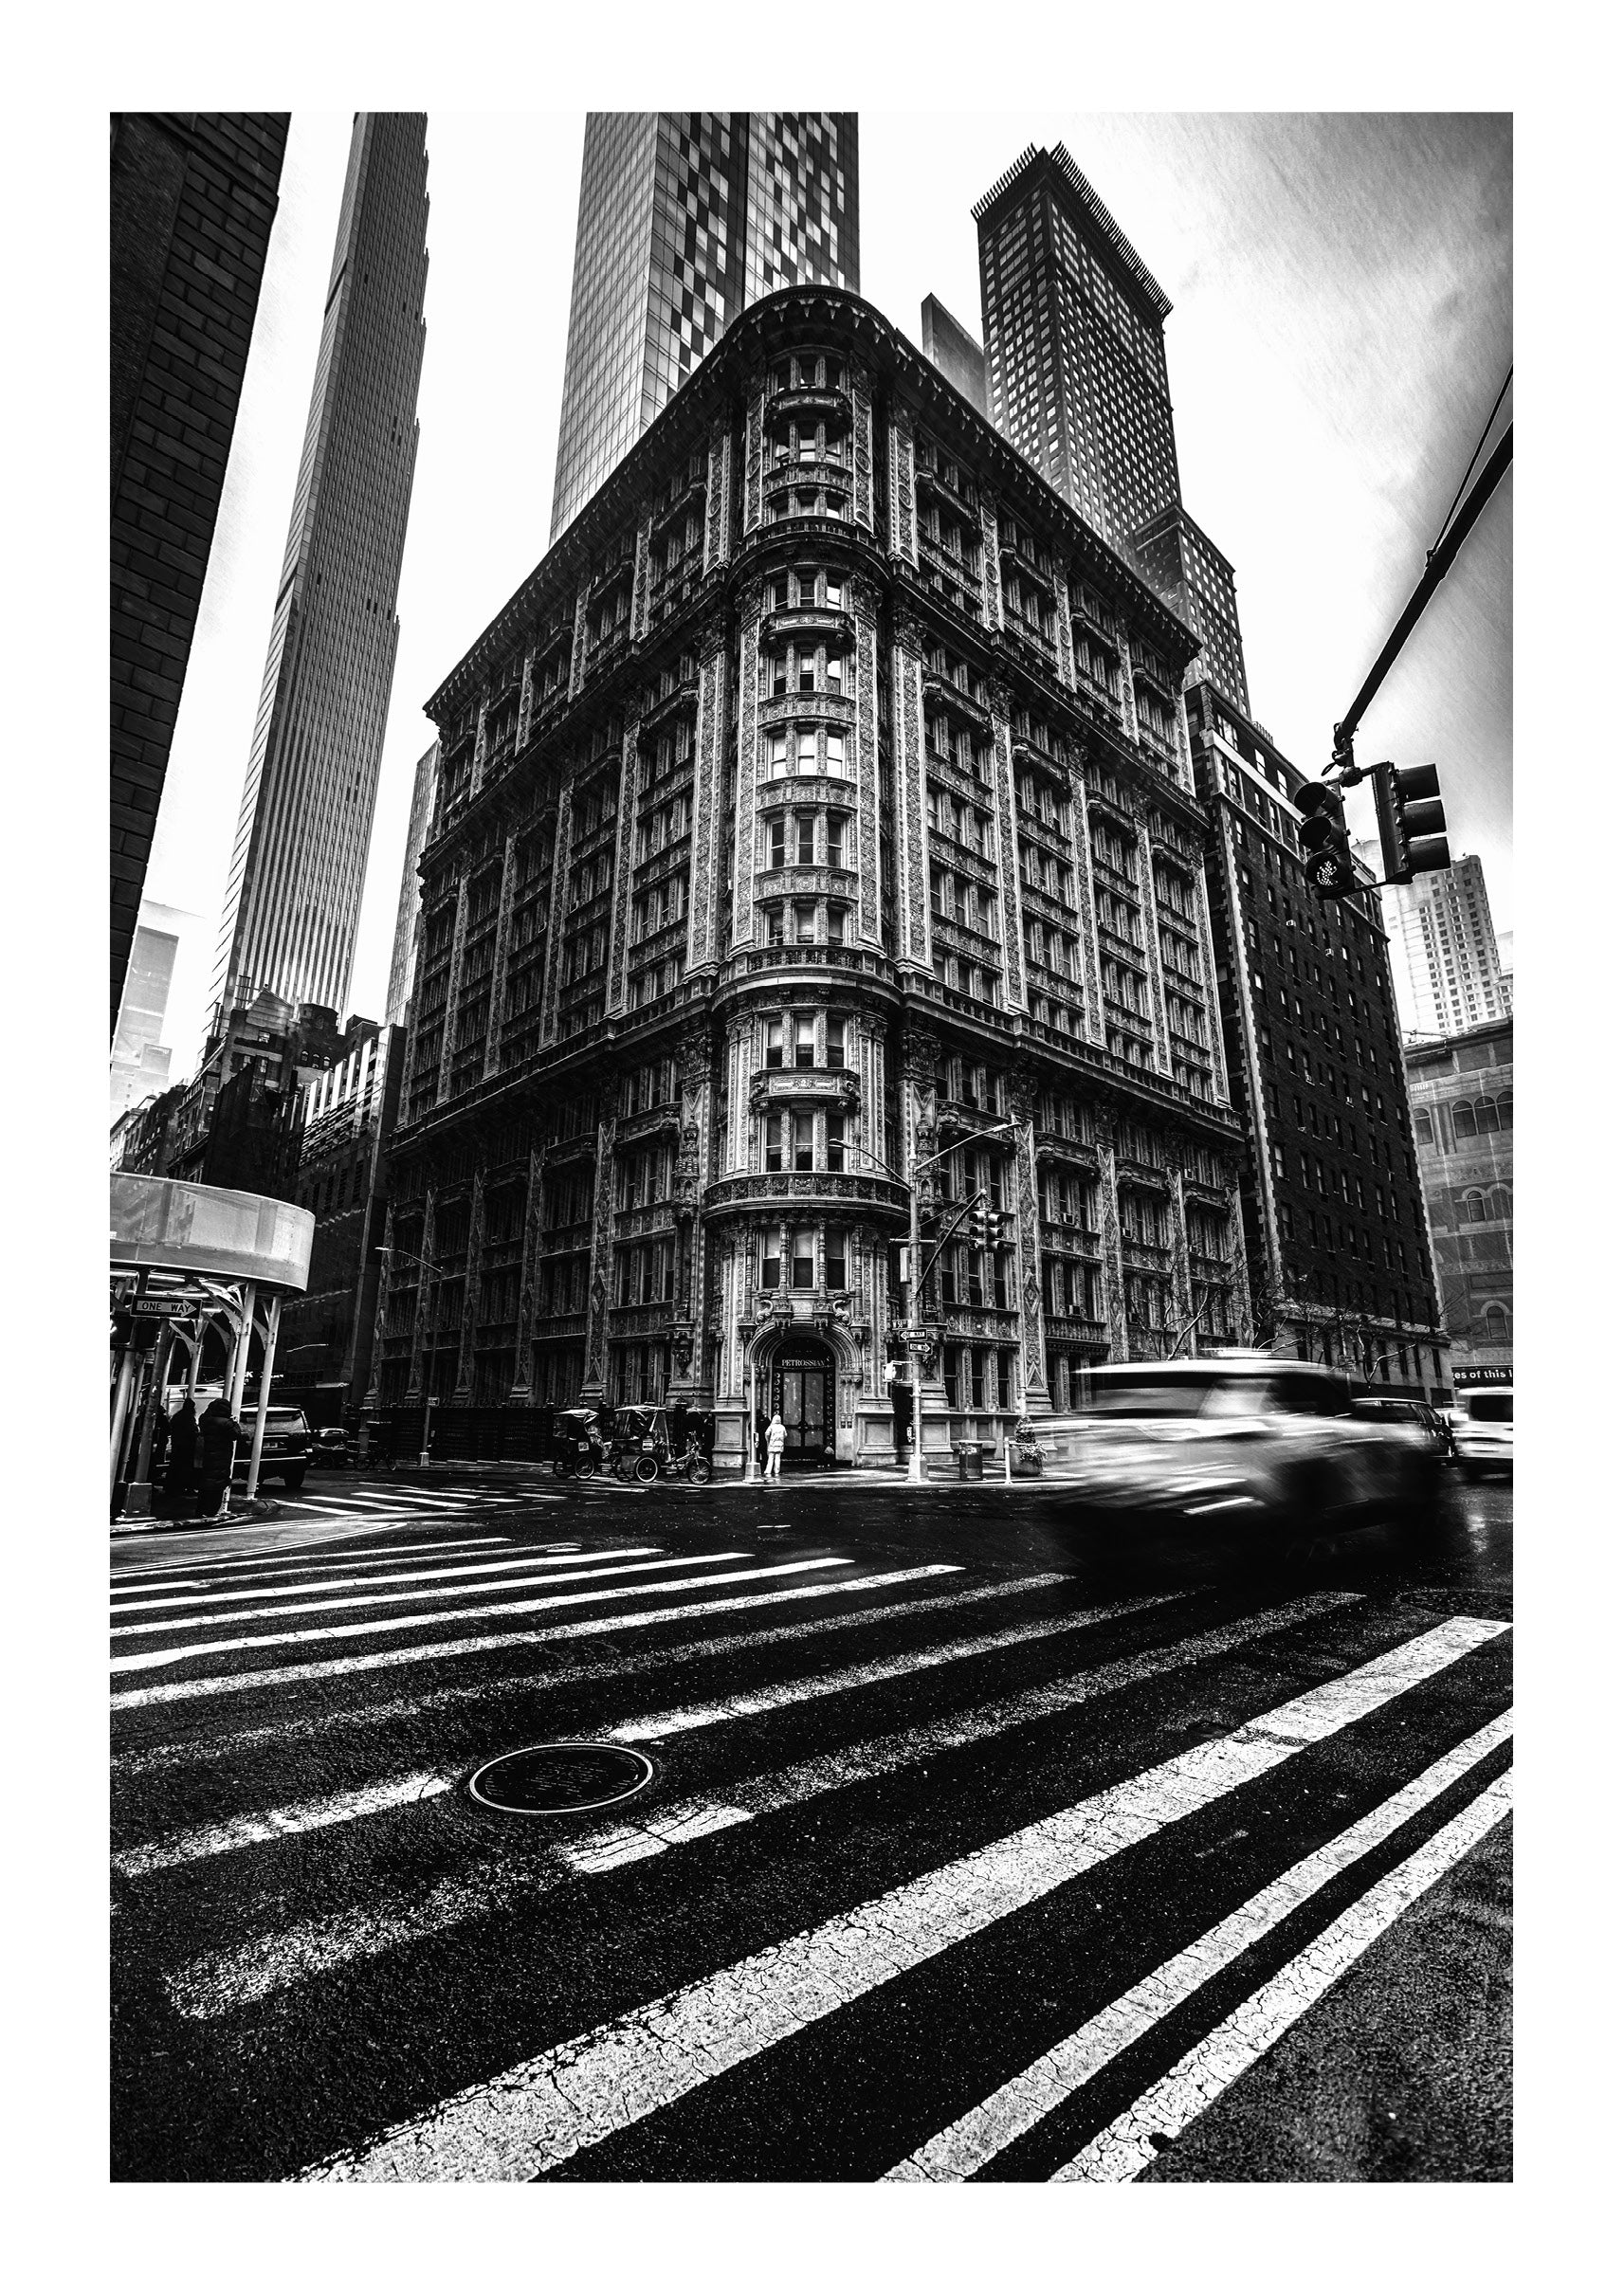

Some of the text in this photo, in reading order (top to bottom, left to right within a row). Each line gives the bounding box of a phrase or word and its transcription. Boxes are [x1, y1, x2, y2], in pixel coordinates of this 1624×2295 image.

[142, 1302, 191, 1313] ONE WAY
[781, 1358, 826, 1367] PETROSSIAN
[1469, 1370, 1481, 1378] of
[1484, 1369, 1506, 1378] this
